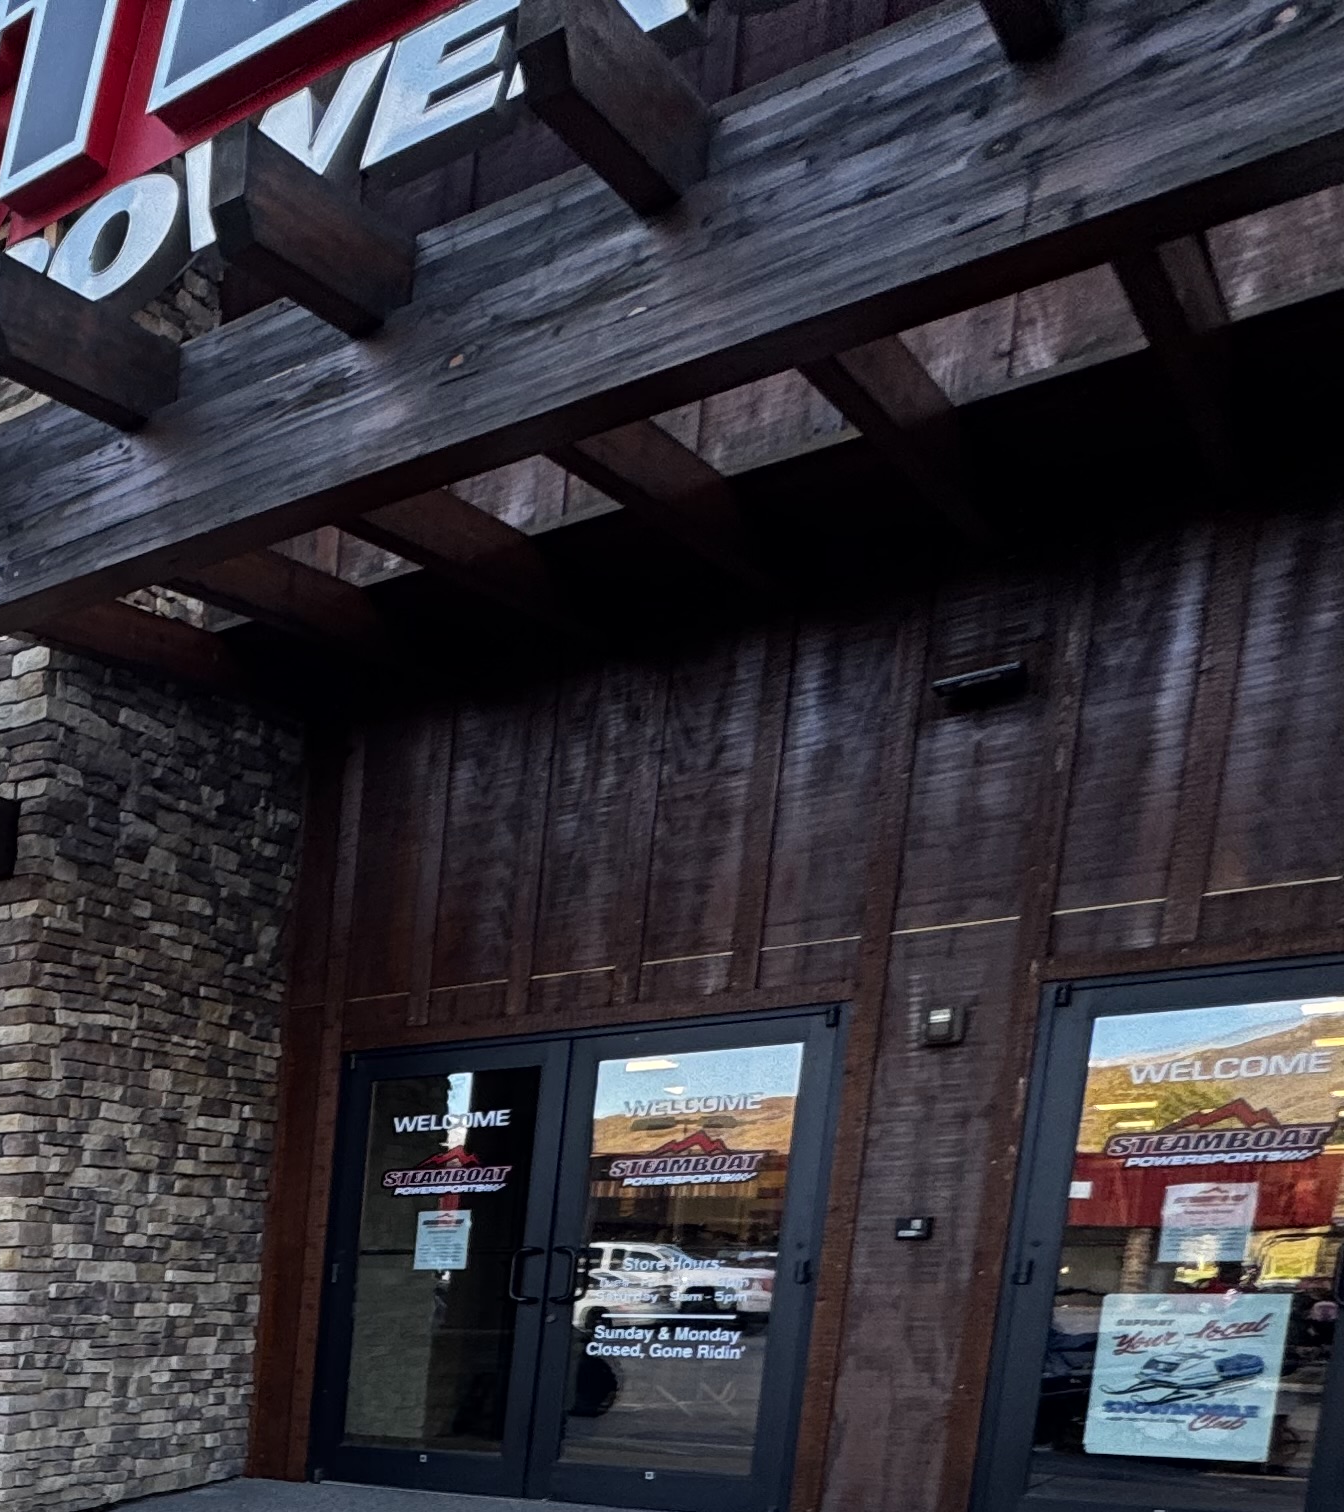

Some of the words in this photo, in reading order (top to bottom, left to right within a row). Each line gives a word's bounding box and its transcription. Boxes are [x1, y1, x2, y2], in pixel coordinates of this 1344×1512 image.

[1127, 1052, 1333, 1084] WELCOME
[624, 1092, 765, 1117] WELCOME
[393, 1109, 512, 1133] WELCOME
[1107, 1126, 1331, 1156] STEAMBOAT
[609, 1152, 765, 1177] STEAMBOAT
[1124, 1151, 1284, 1168] POWERSPORTS
[382, 1165, 512, 1187] STEAMBOAT
[623, 1257, 665, 1271] Store
[714, 1291, 748, 1304] 5pm
[594, 1325, 654, 1343] Sunday
[658, 1327, 669, 1340] &
[674, 1327, 742, 1344] Monday
[586, 1342, 646, 1359] Closed,
[650, 1343, 693, 1358] Gone
